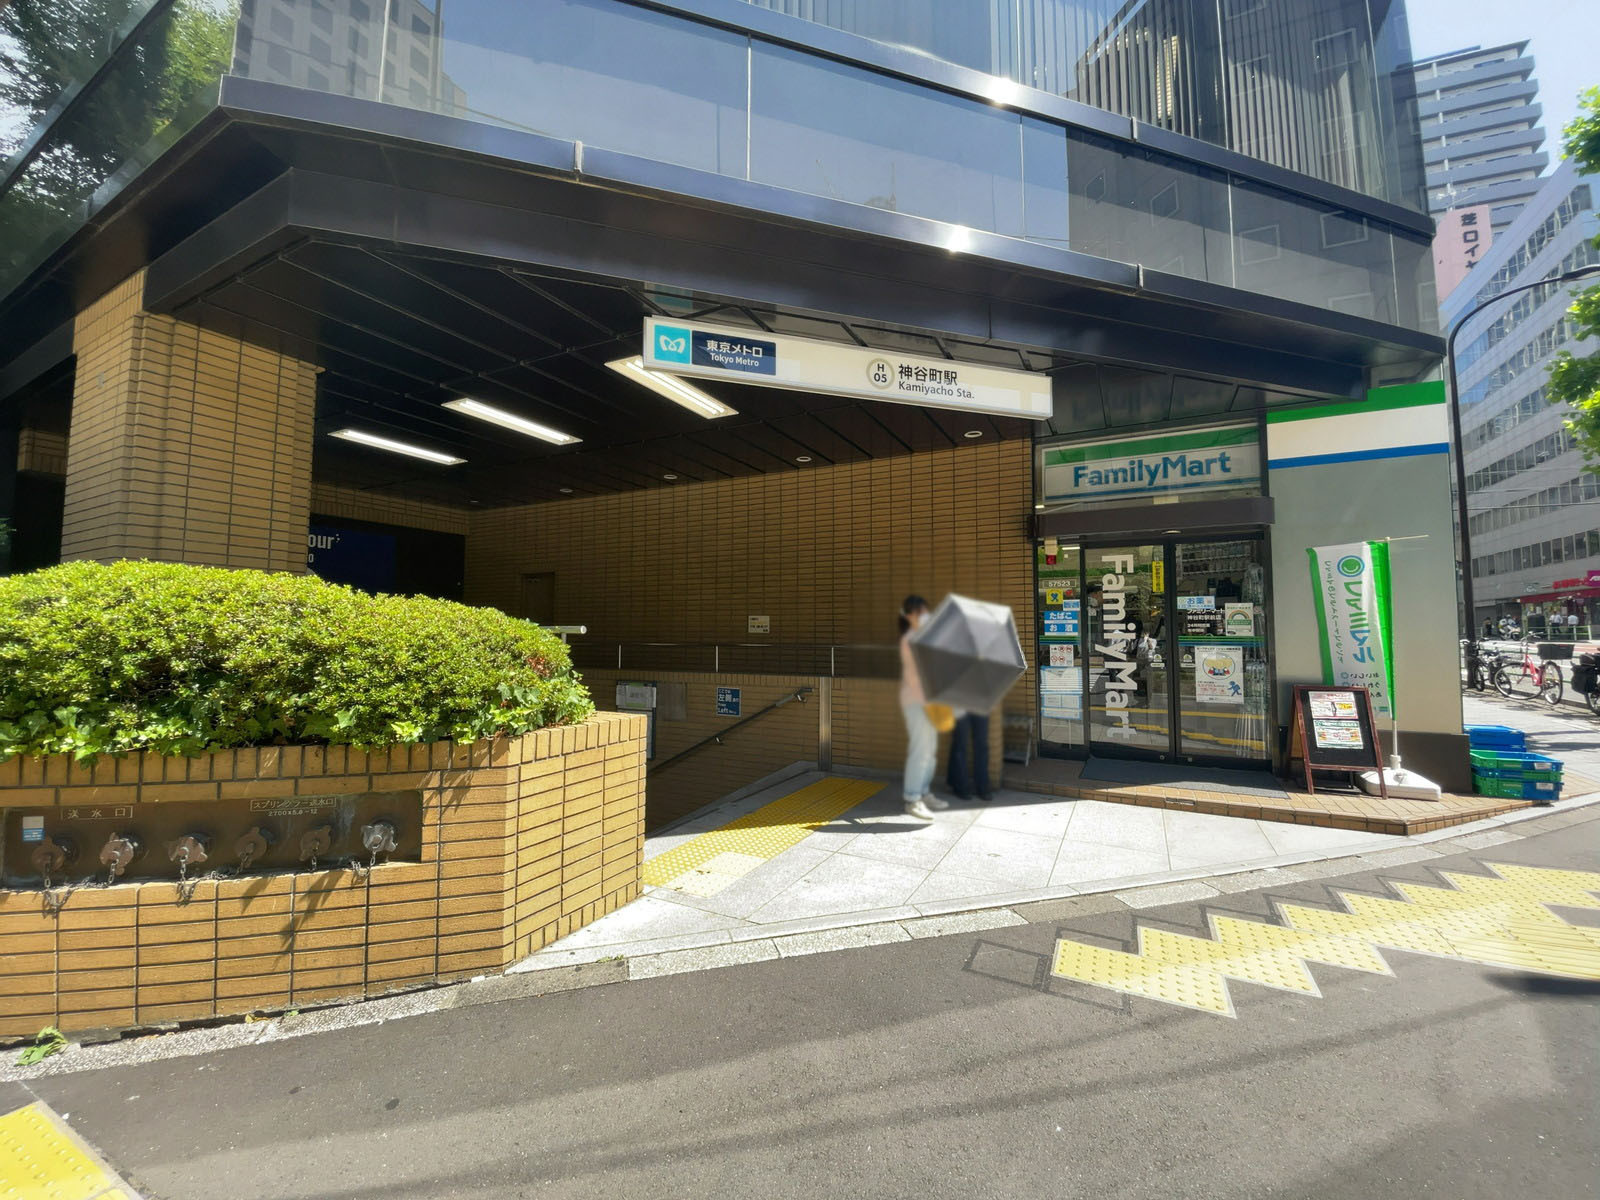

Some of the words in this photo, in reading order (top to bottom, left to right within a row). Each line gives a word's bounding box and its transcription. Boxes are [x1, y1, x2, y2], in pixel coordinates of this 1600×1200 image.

[706, 340, 763, 358] 東京メトロ
[710, 353, 734, 364] Tokyo
[735, 356, 760, 367] Metro
[877, 363, 885, 372] H
[873, 373, 888, 384] 05
[898, 364, 958, 386] 神谷町駅
[898, 380, 954, 397] Kamiyacho
[956, 388, 975, 399] Sta.
[1073, 451, 1232, 488] FamilyMart
[1049, 612, 1073, 620] たばこ
[1094, 554, 1138, 739] FamilyMart
